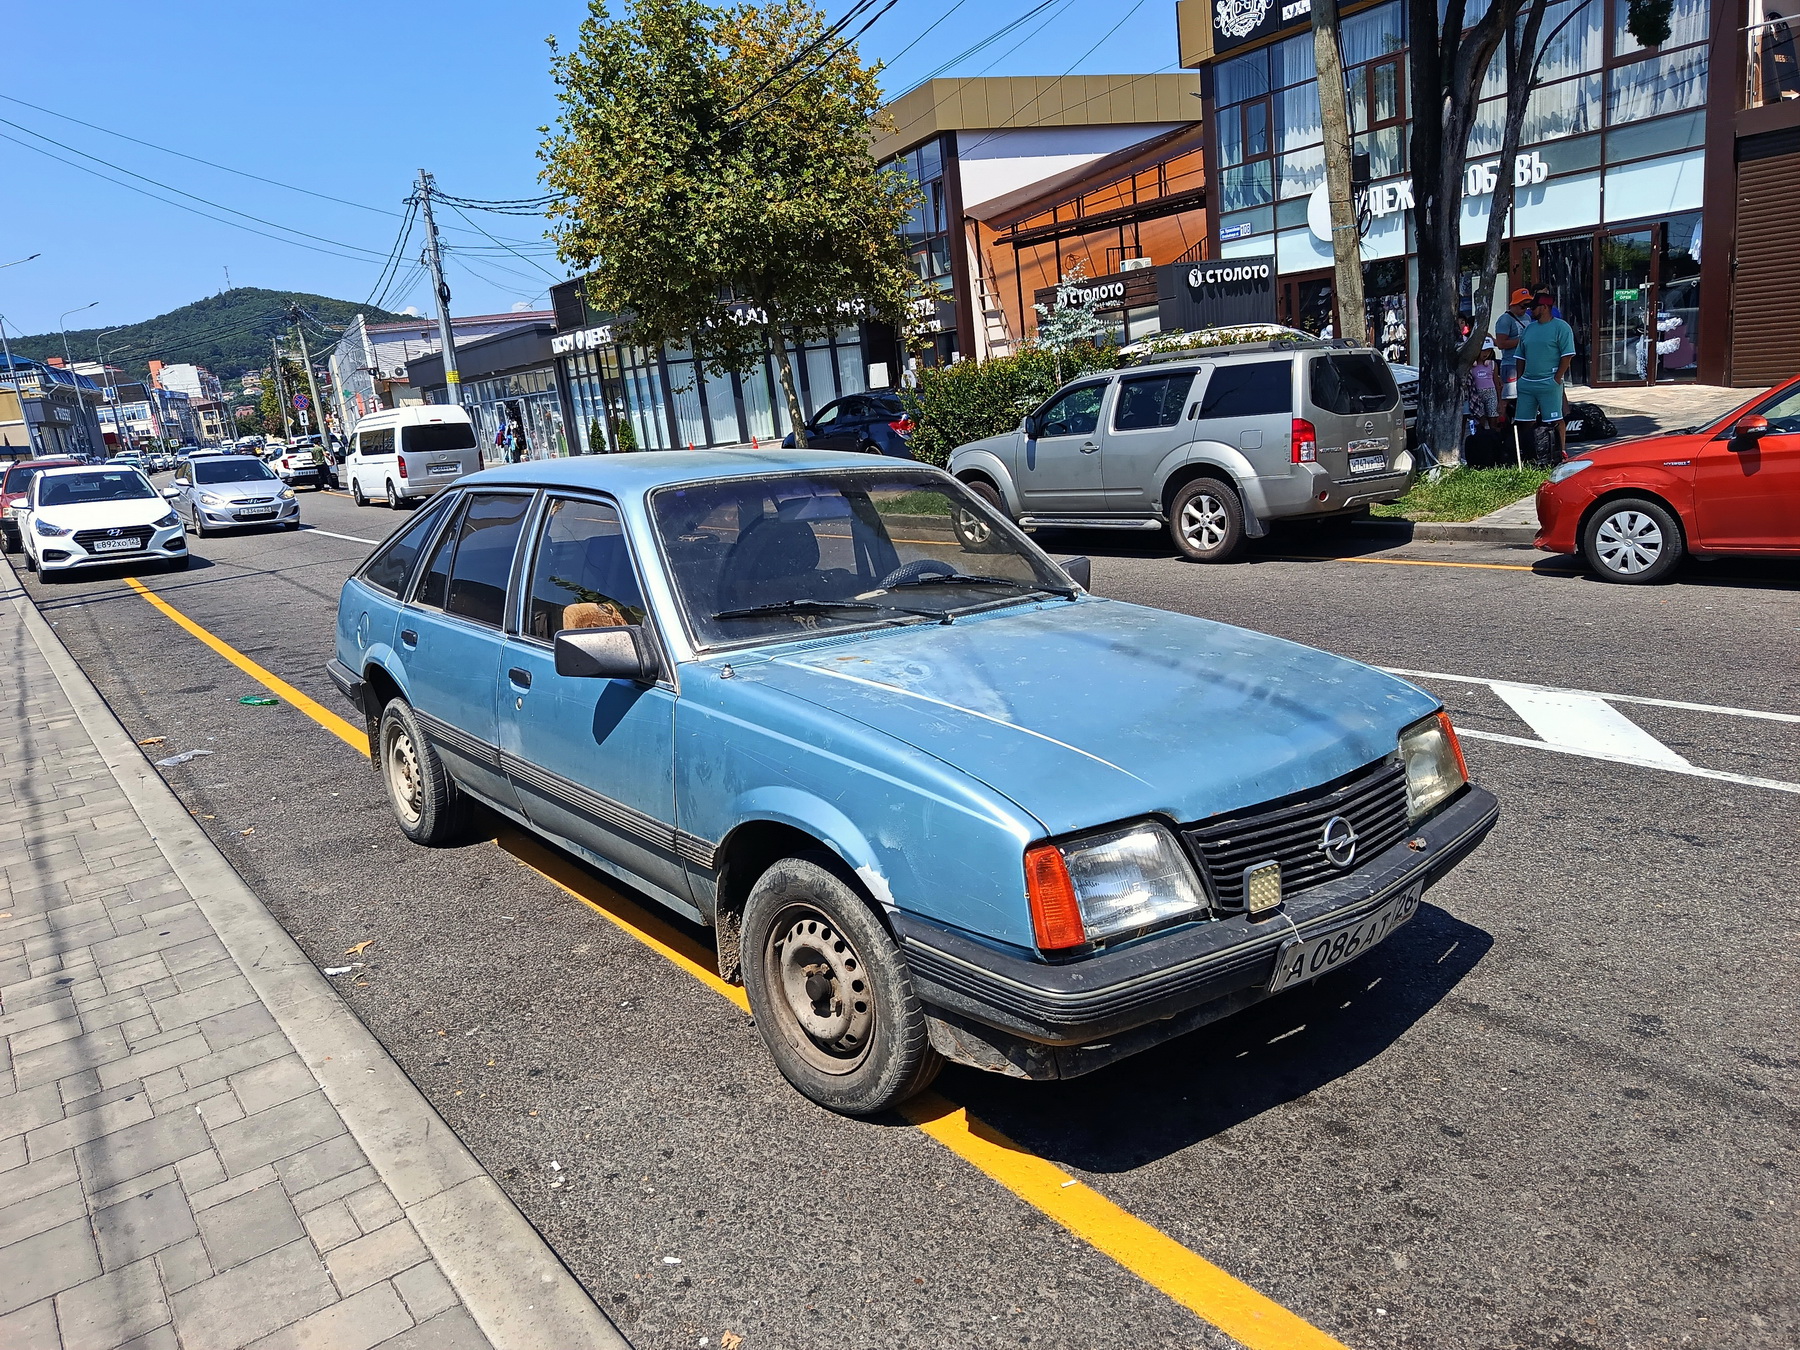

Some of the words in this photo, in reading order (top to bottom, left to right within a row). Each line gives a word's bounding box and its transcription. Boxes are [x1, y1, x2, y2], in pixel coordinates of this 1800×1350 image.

[1467, 151, 1548, 196] ОБВЬ
[1205, 264, 1270, 284] СТОЛОТО
[1070, 282, 1124, 304] СТОЛОТО
[1565, 419, 1584, 431] IKE
